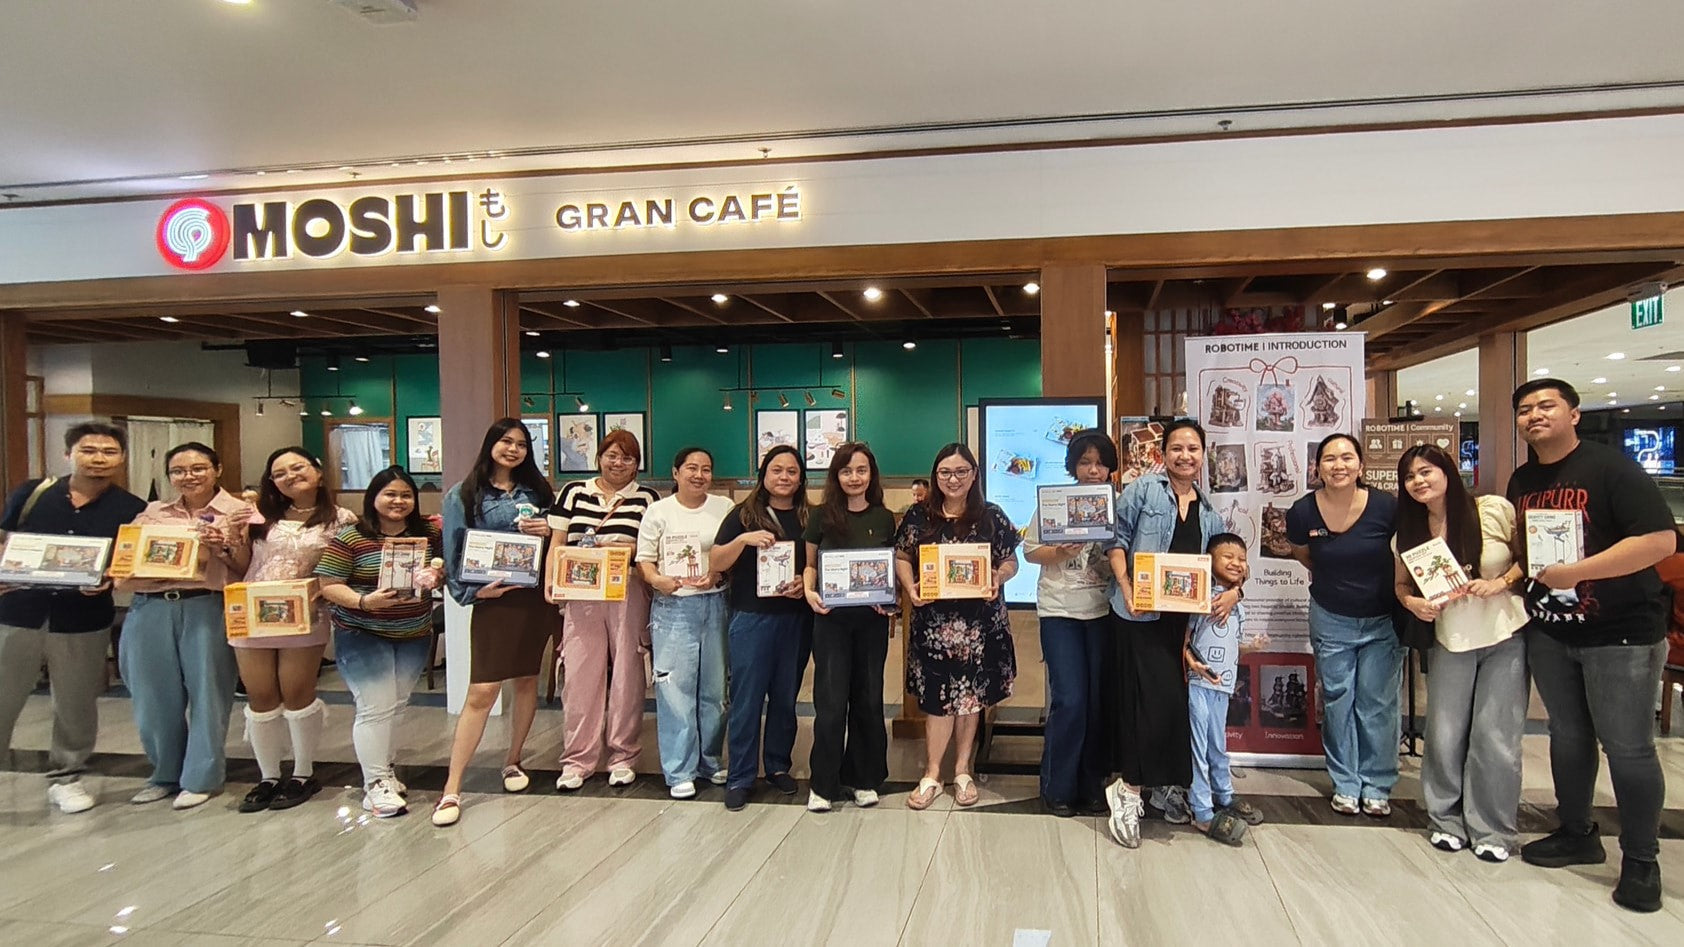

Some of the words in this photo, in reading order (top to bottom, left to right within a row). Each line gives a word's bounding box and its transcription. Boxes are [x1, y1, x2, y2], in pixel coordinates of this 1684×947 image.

[556, 199, 673, 229] GRAN
[689, 186, 799, 222] CAFÉ
[480, 188, 506, 249] もし
[233, 191, 470, 260] MOSHI
[1636, 296, 1660, 327] EXIT
[1205, 343, 1259, 353] ROBOTIME
[1268, 340, 1347, 350] INTRODUCTION
[1365, 424, 1405, 432] ROBOTIME
[1410, 423, 1454, 432] Community
[1365, 470, 1398, 480] SUPER
[1263, 569, 1292, 578] Building
[1255, 578, 1278, 587] Things
[1289, 578, 1305, 586] Life
[1264, 731, 1304, 740] Innovation
